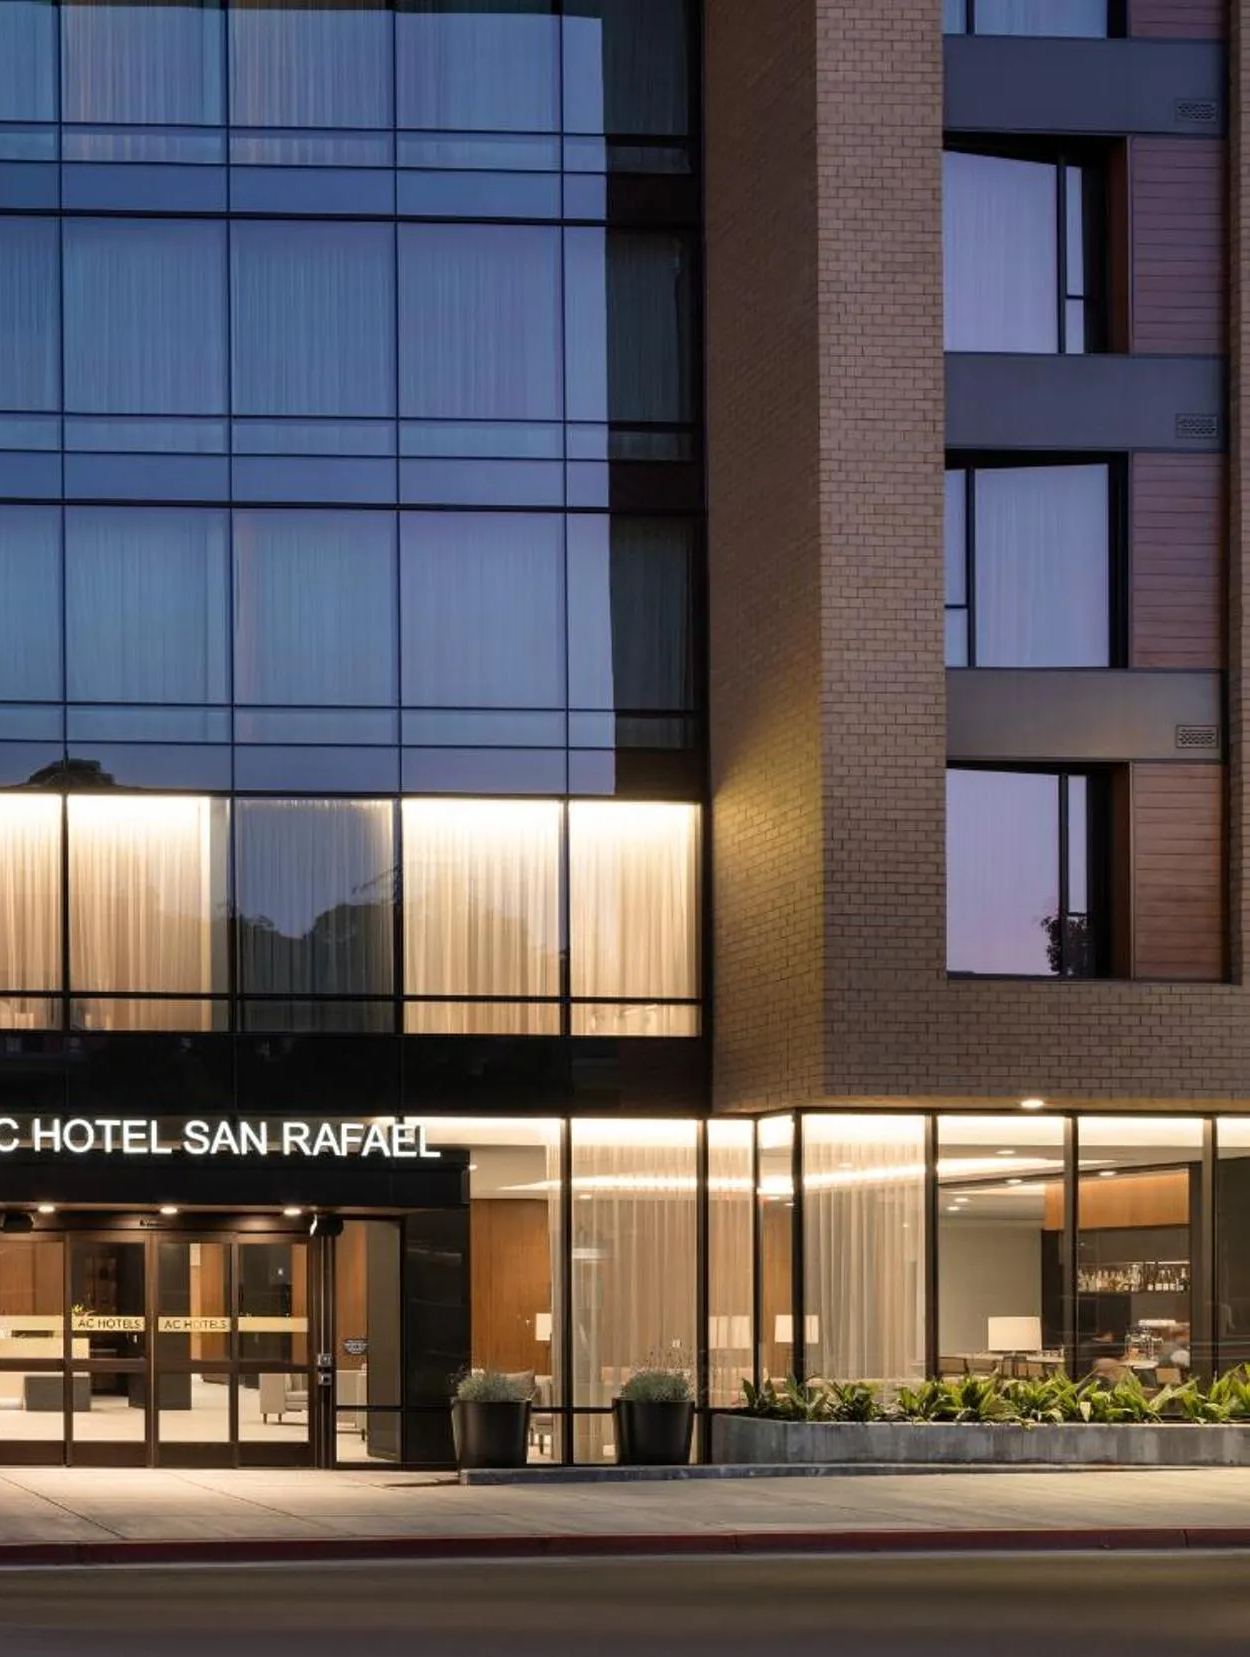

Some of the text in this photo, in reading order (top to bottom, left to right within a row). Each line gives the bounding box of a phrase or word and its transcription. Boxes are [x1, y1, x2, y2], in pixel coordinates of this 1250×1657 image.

[33, 1118, 172, 1154] HOTEL
[183, 1120, 268, 1155] SAN
[282, 1122, 442, 1158] RAFAEL
[78, 1318, 141, 1329] AC HOTELS
[164, 1319, 181, 1329] AC
